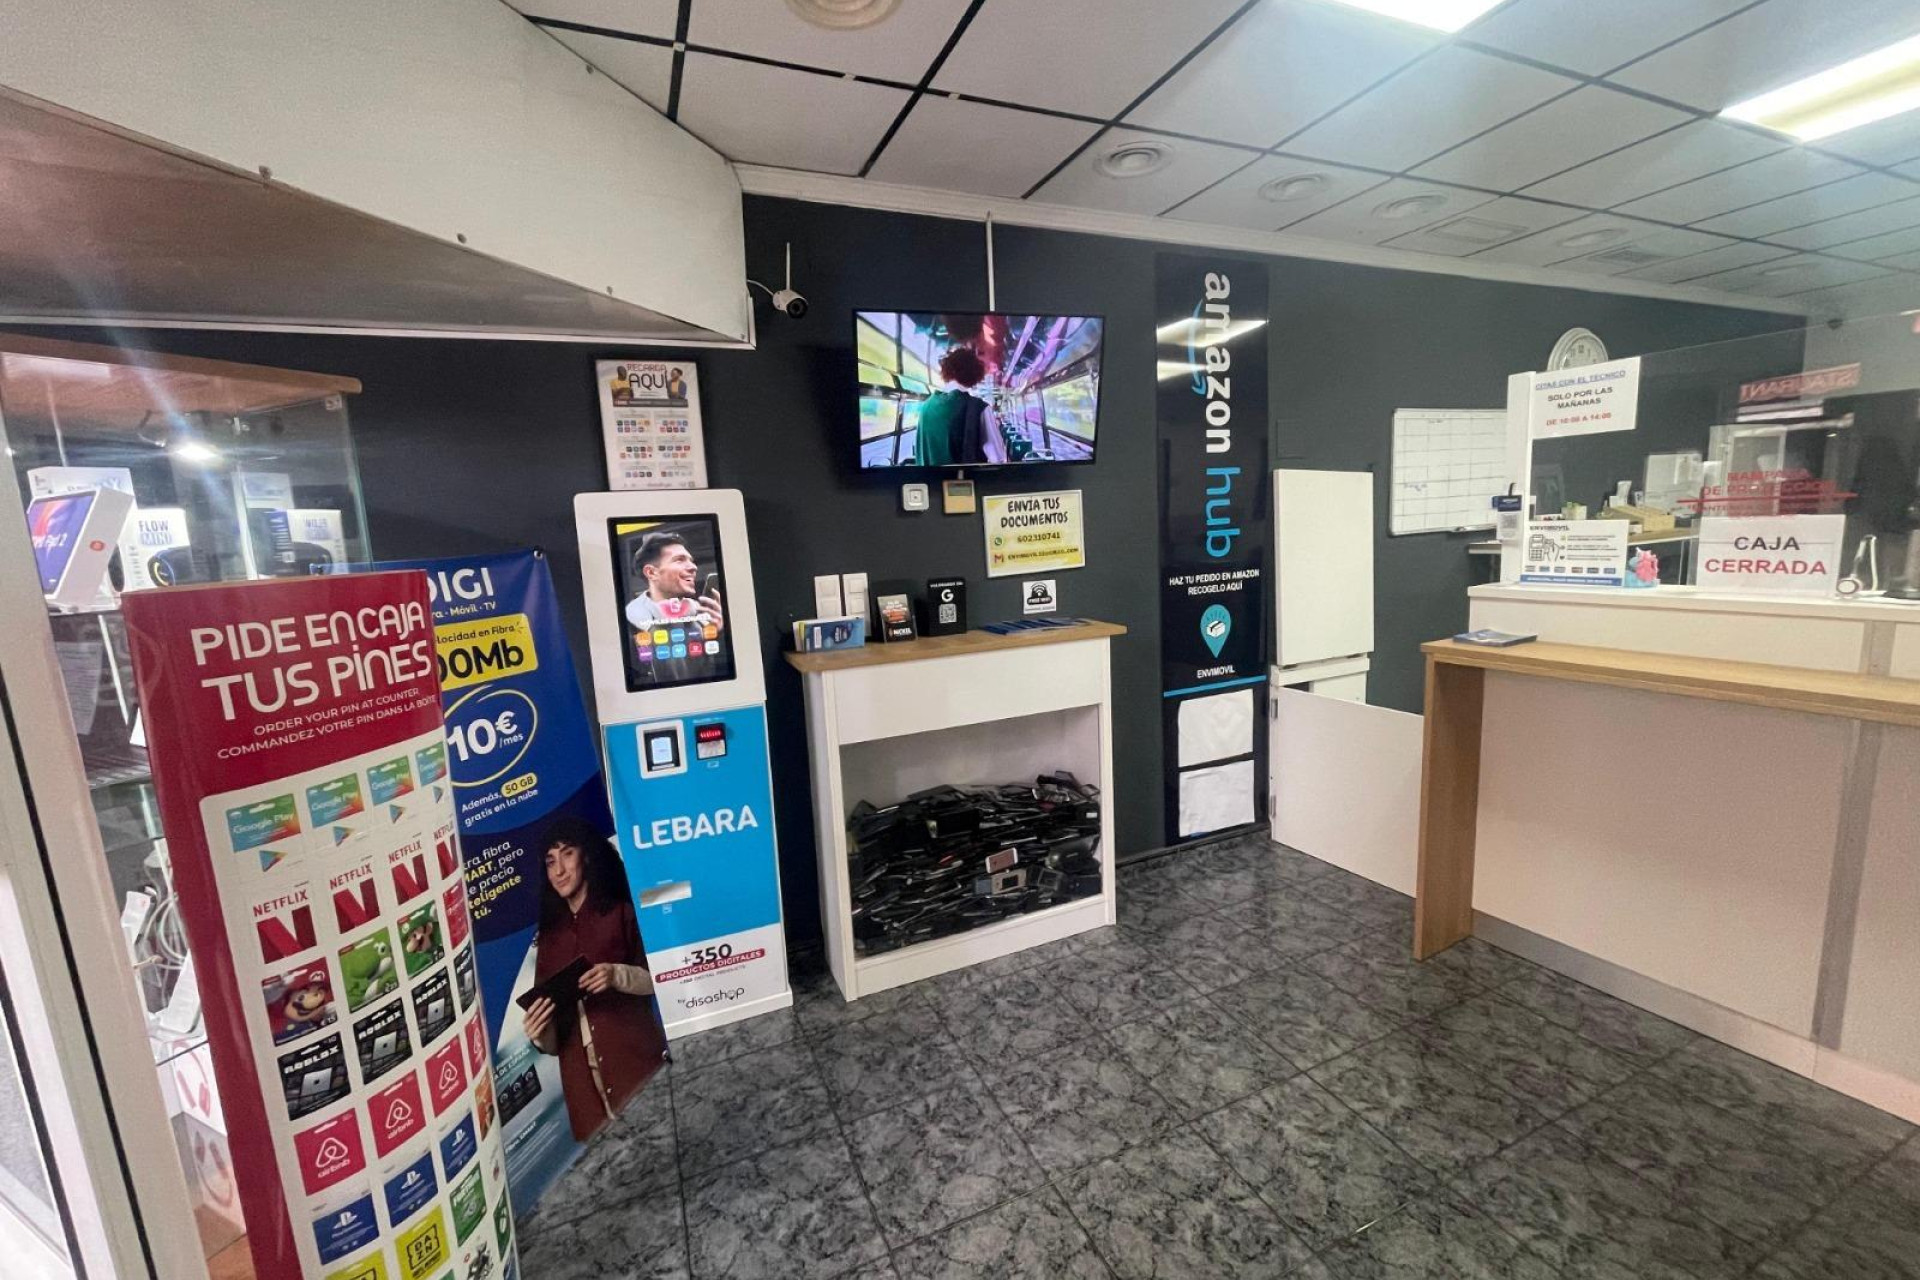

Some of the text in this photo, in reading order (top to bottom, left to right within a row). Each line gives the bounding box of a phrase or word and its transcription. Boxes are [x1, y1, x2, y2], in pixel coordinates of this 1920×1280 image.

[1547, 387, 1613, 402] SOLO POR LAS
[1557, 397, 1602, 409] MAÑANAS
[1204, 271, 1241, 558] amazon hub
[1042, 496, 1061, 510] TUS
[1001, 511, 1068, 529] DOCUMENTOS
[1734, 536, 1800, 551] CAJA
[1705, 559, 1827, 575] CERRADA
[1169, 568, 1260, 587] HAZ TU PEDIDO EN AMAZON
[450, 603, 478, 617] Móvil
[483, 601, 496, 611] TV
[191, 601, 426, 667] PIDE EN CAJA
[437, 625, 515, 645] locidad en Fibra
[1197, 665, 1236, 679] ENVIMOVIL
[201, 662, 320, 721] TUS
[254, 687, 420, 736] ORDER YOUR PIN AT COUNTER
[217, 728, 315, 760] COMMANDEZ
[317, 718, 355, 736] VOTRE
[356, 712, 375, 727] PIN
[376, 705, 404, 721] DANS
[404, 701, 416, 714] LA
[500, 733, 524, 748] /mes
[505, 783, 518, 795] 50
[520, 776, 534, 788] GB
[465, 789, 538, 828] gratis en la nube
[633, 805, 758, 850] LEBARA
[388, 840, 423, 864] NETFLIX
[482, 841, 511, 860] fibra
[498, 848, 524, 868] pero
[329, 863, 373, 890] NETFLIX
[479, 866, 514, 892] precio
[253, 888, 310, 918] NETFLIX
[682, 944, 732, 965] +350
[660, 950, 762, 981] PRODUCTOS DIGITALES
[686, 988, 744, 1009] disashop
[284, 1045, 339, 1074] ROBLOX
[317, 1159, 351, 1179] airbnb
